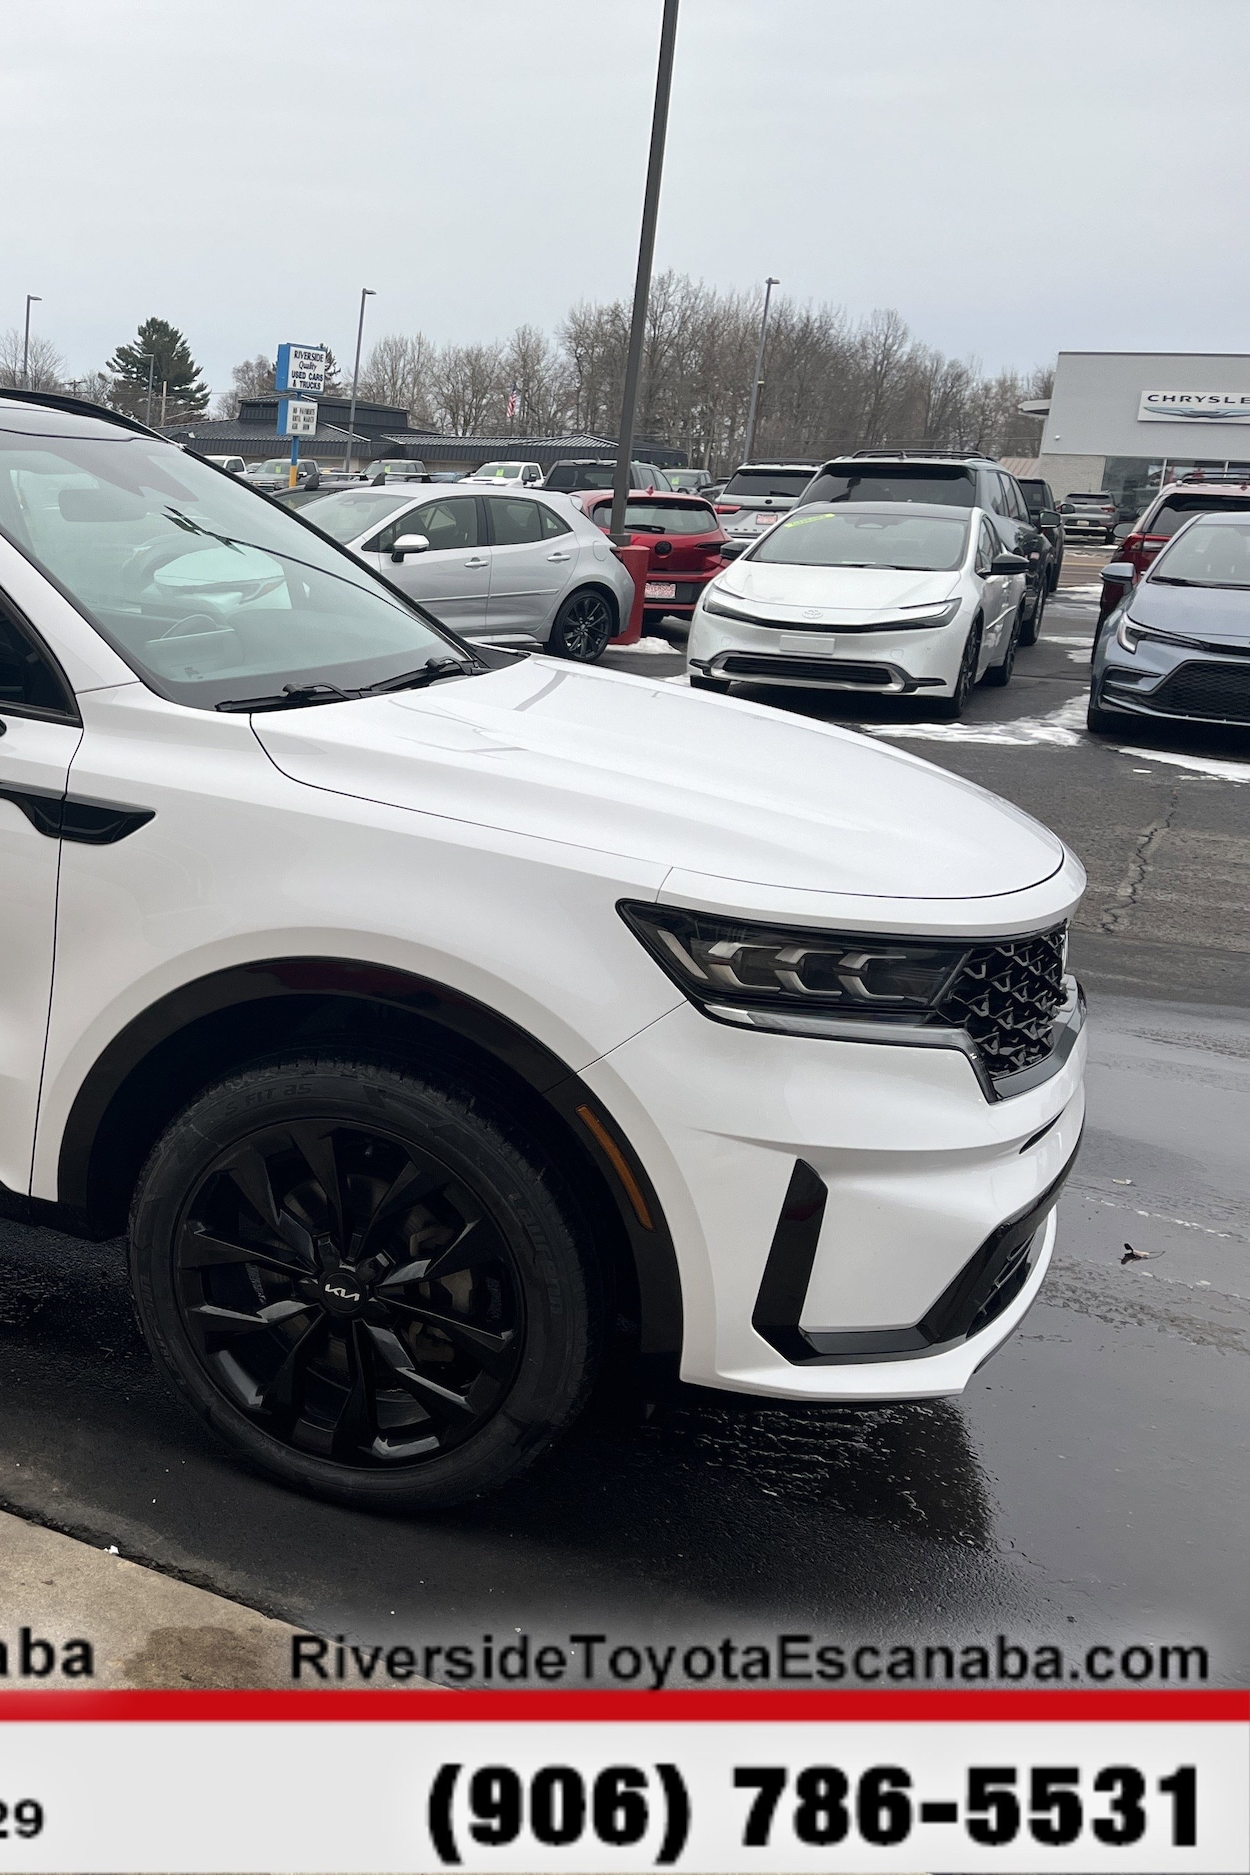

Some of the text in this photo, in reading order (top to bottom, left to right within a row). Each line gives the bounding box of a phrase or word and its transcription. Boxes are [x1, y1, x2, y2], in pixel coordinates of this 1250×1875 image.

[294, 350, 324, 362] RIVERSIDE
[299, 361, 317, 372] Quality
[292, 370, 323, 382] USED CARS
[299, 380, 321, 390] TRUCKS
